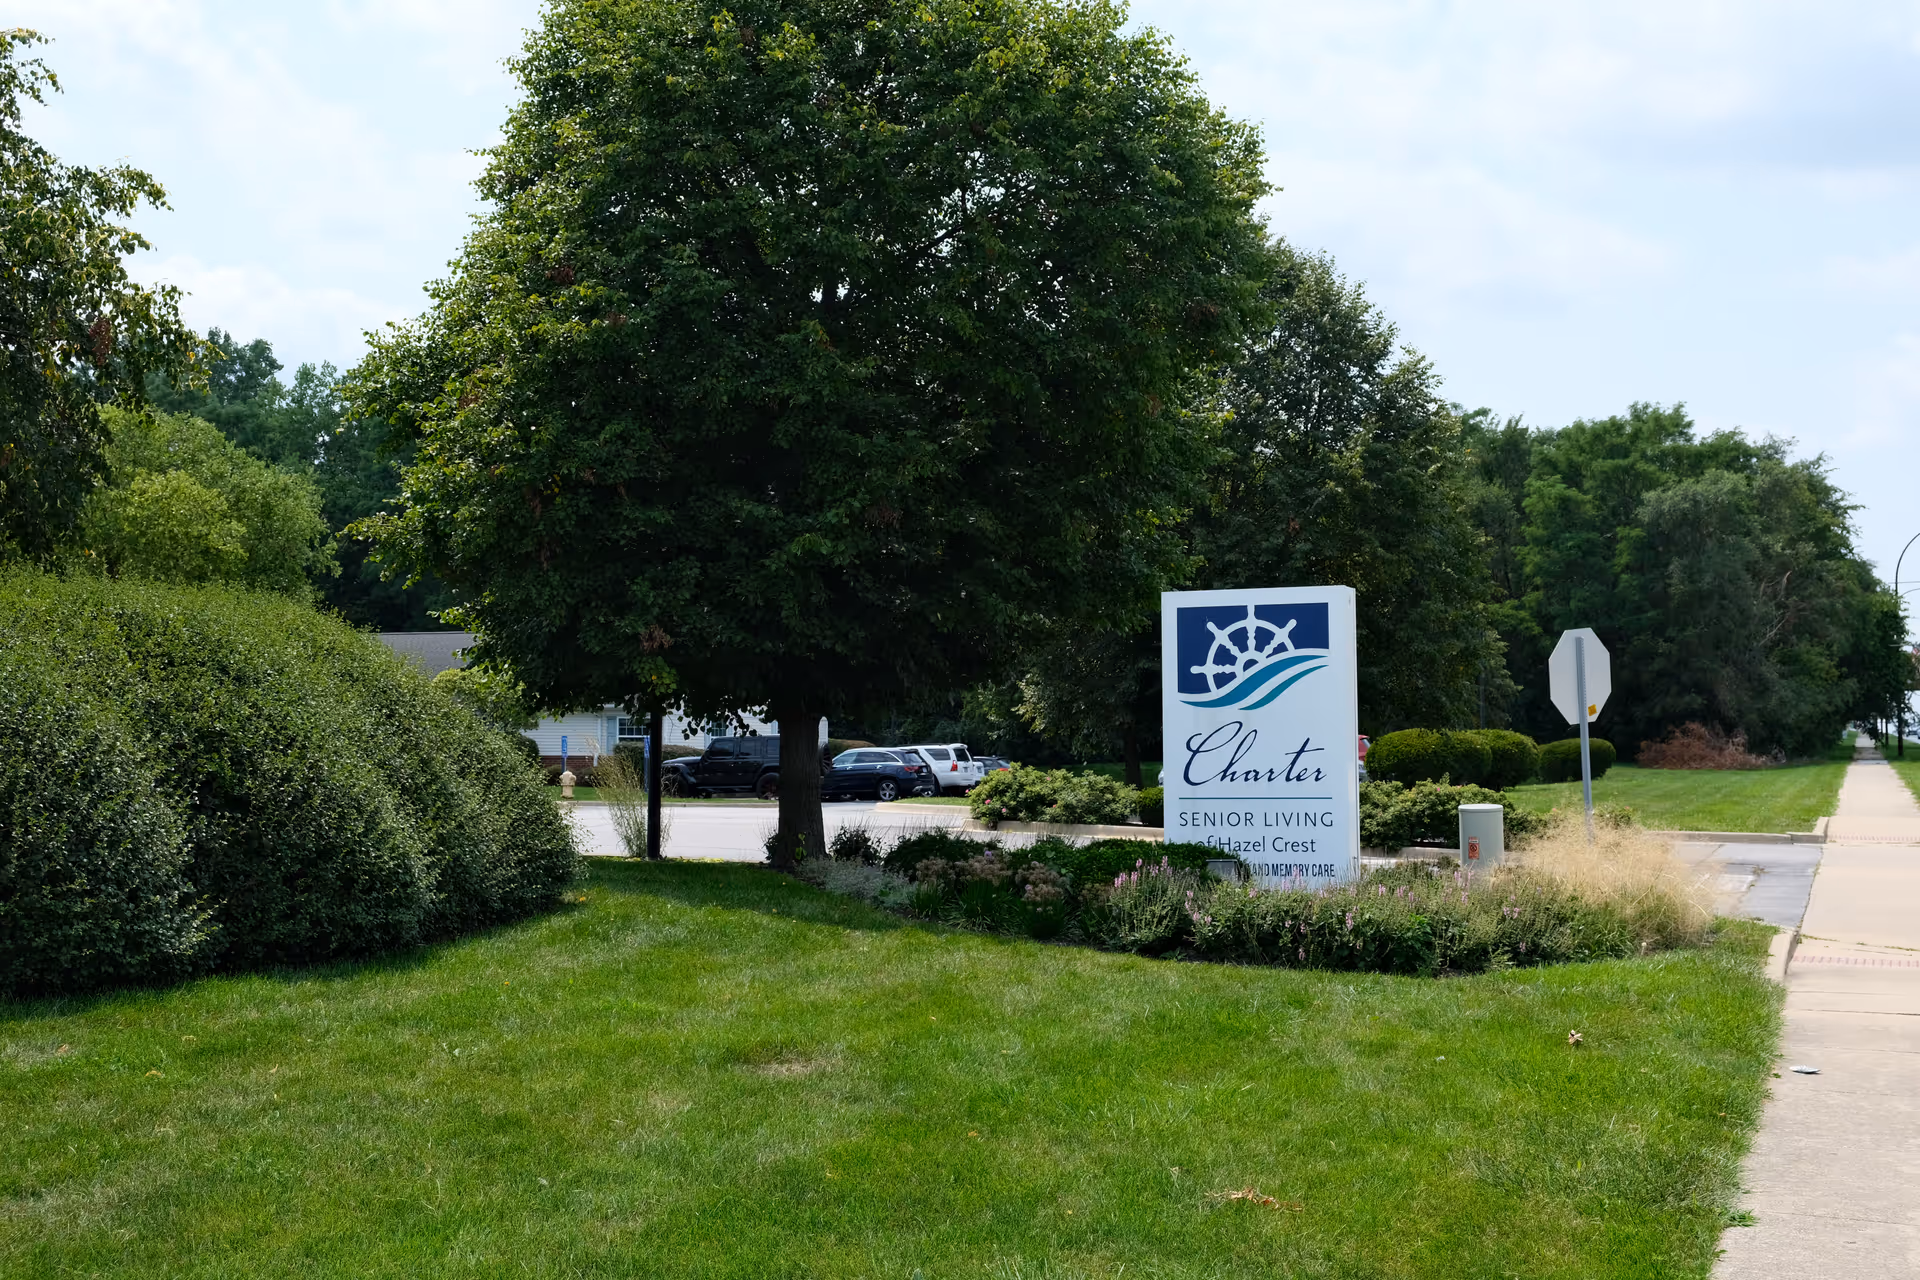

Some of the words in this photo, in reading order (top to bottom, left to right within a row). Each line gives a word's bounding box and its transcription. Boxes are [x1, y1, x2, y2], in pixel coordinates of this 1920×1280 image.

[1183, 720, 1327, 787] Charter
[1179, 811, 1254, 827] SENIOR
[1264, 811, 1334, 827] LIVING
[1218, 835, 1266, 853] Hazel
[1272, 836, 1316, 853] Crest
[1311, 863, 1335, 877] CARE
